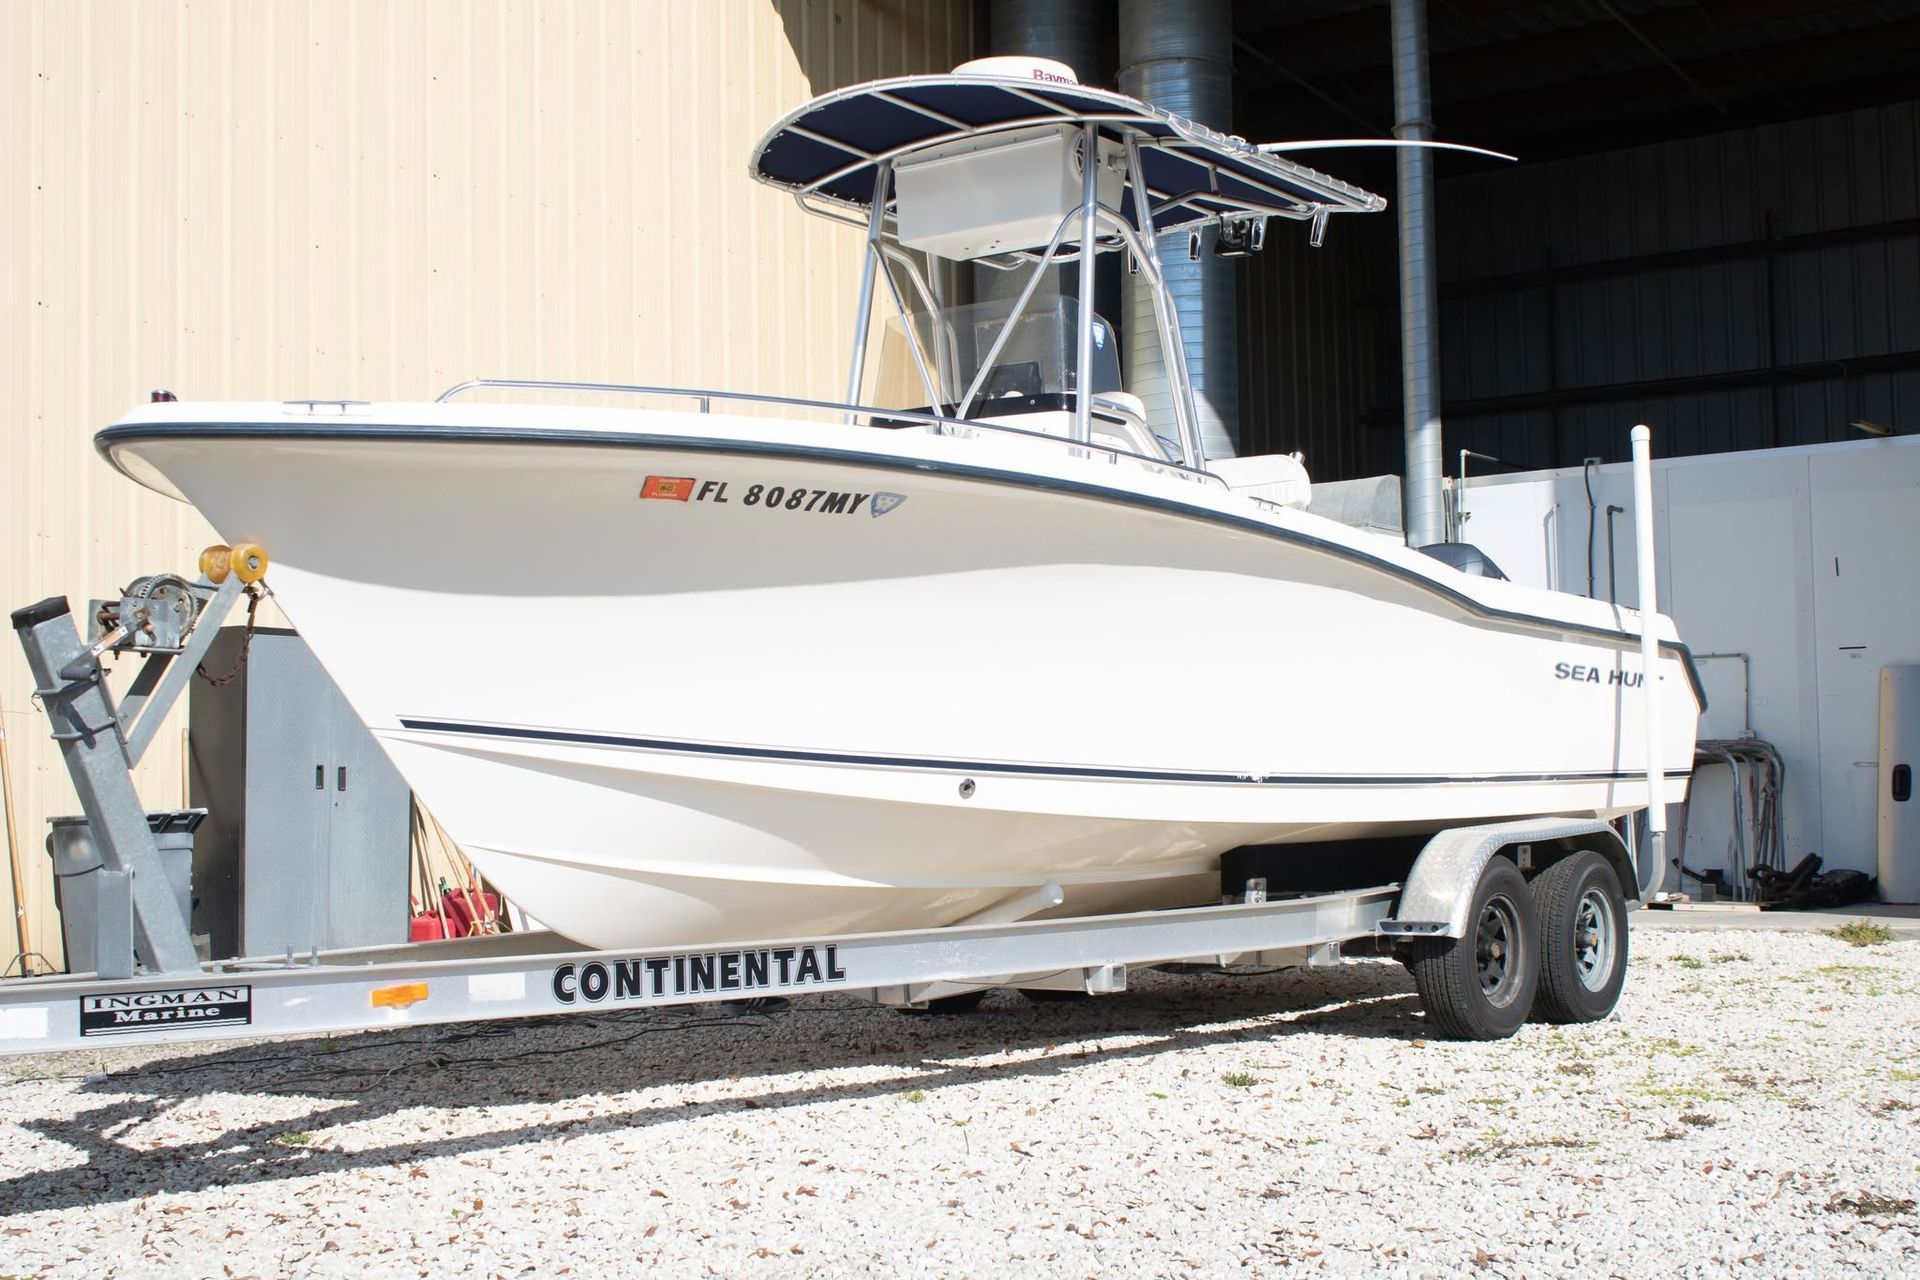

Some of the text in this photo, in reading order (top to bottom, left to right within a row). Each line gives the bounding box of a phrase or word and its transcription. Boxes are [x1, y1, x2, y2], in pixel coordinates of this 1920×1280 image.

[696, 481, 870, 514] FL 8087MY
[1555, 662, 1600, 684] SEA
[551, 944, 846, 1005] CONTINENTAL
[92, 989, 240, 1010] INGMAN
[113, 1007, 221, 1023] Marine
